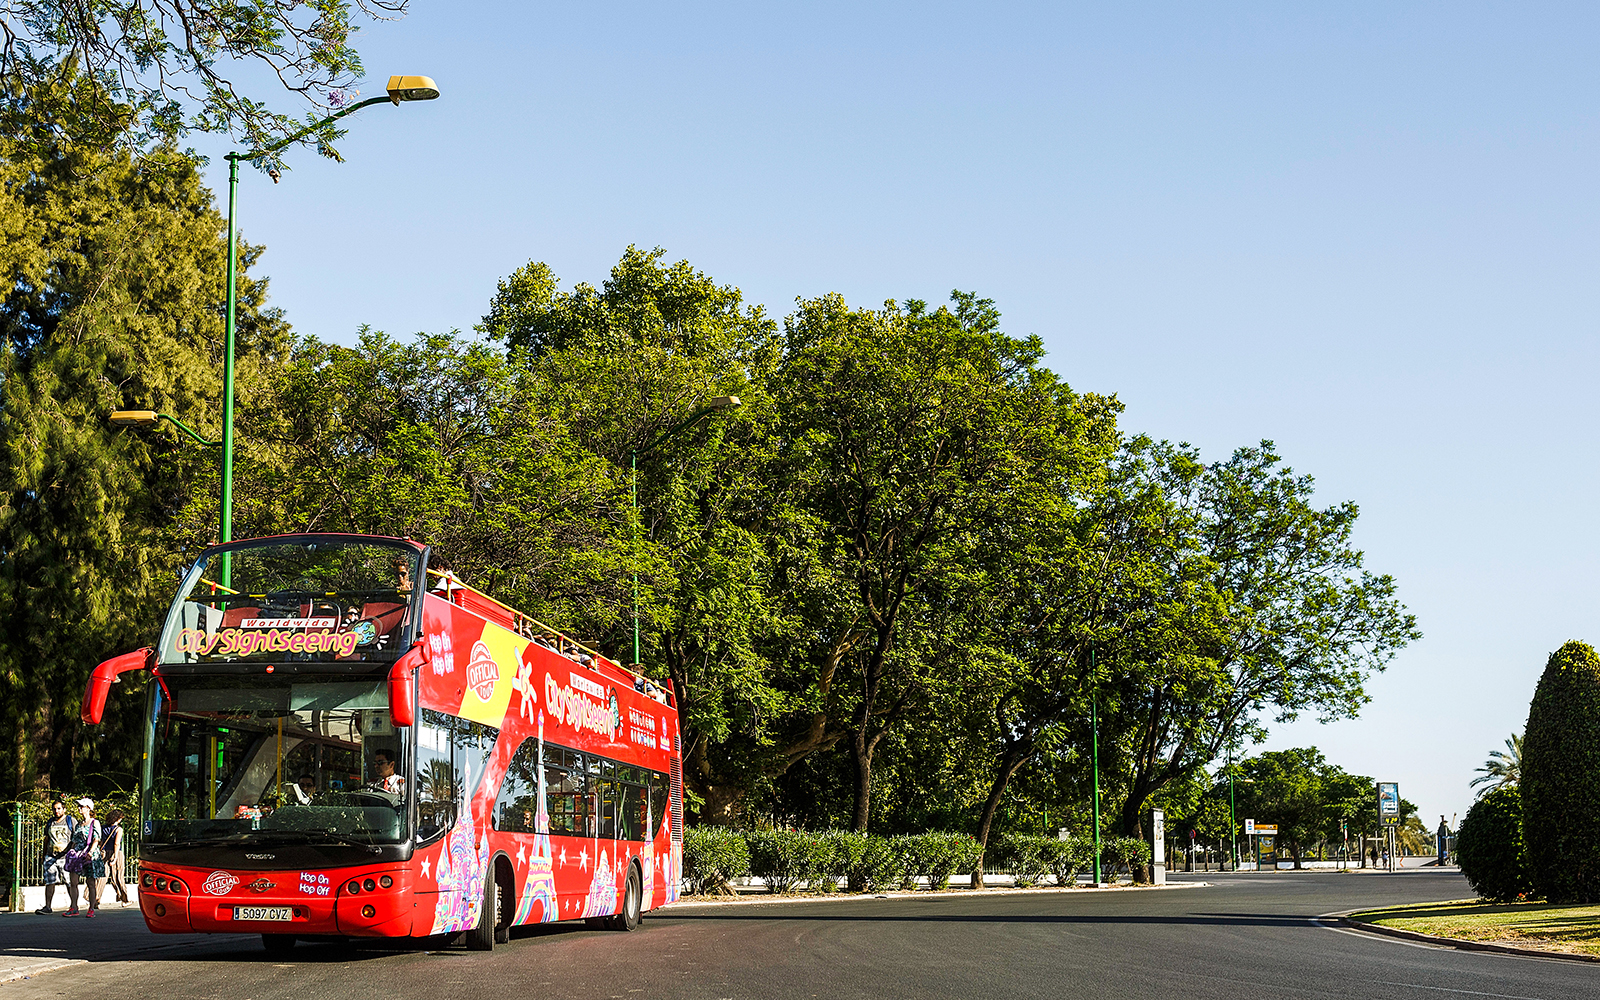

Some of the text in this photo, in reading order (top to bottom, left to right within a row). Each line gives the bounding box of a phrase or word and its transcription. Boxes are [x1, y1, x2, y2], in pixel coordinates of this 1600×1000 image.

[246, 619, 330, 627] Worldwide
[469, 662, 499, 686] OFFICIAL
[205, 877, 238, 891] OFFICIAL
[300, 872, 330, 885] Hop On
[299, 883, 331, 896] Hop Off
[243, 908, 289, 920] 5097 CVZ
